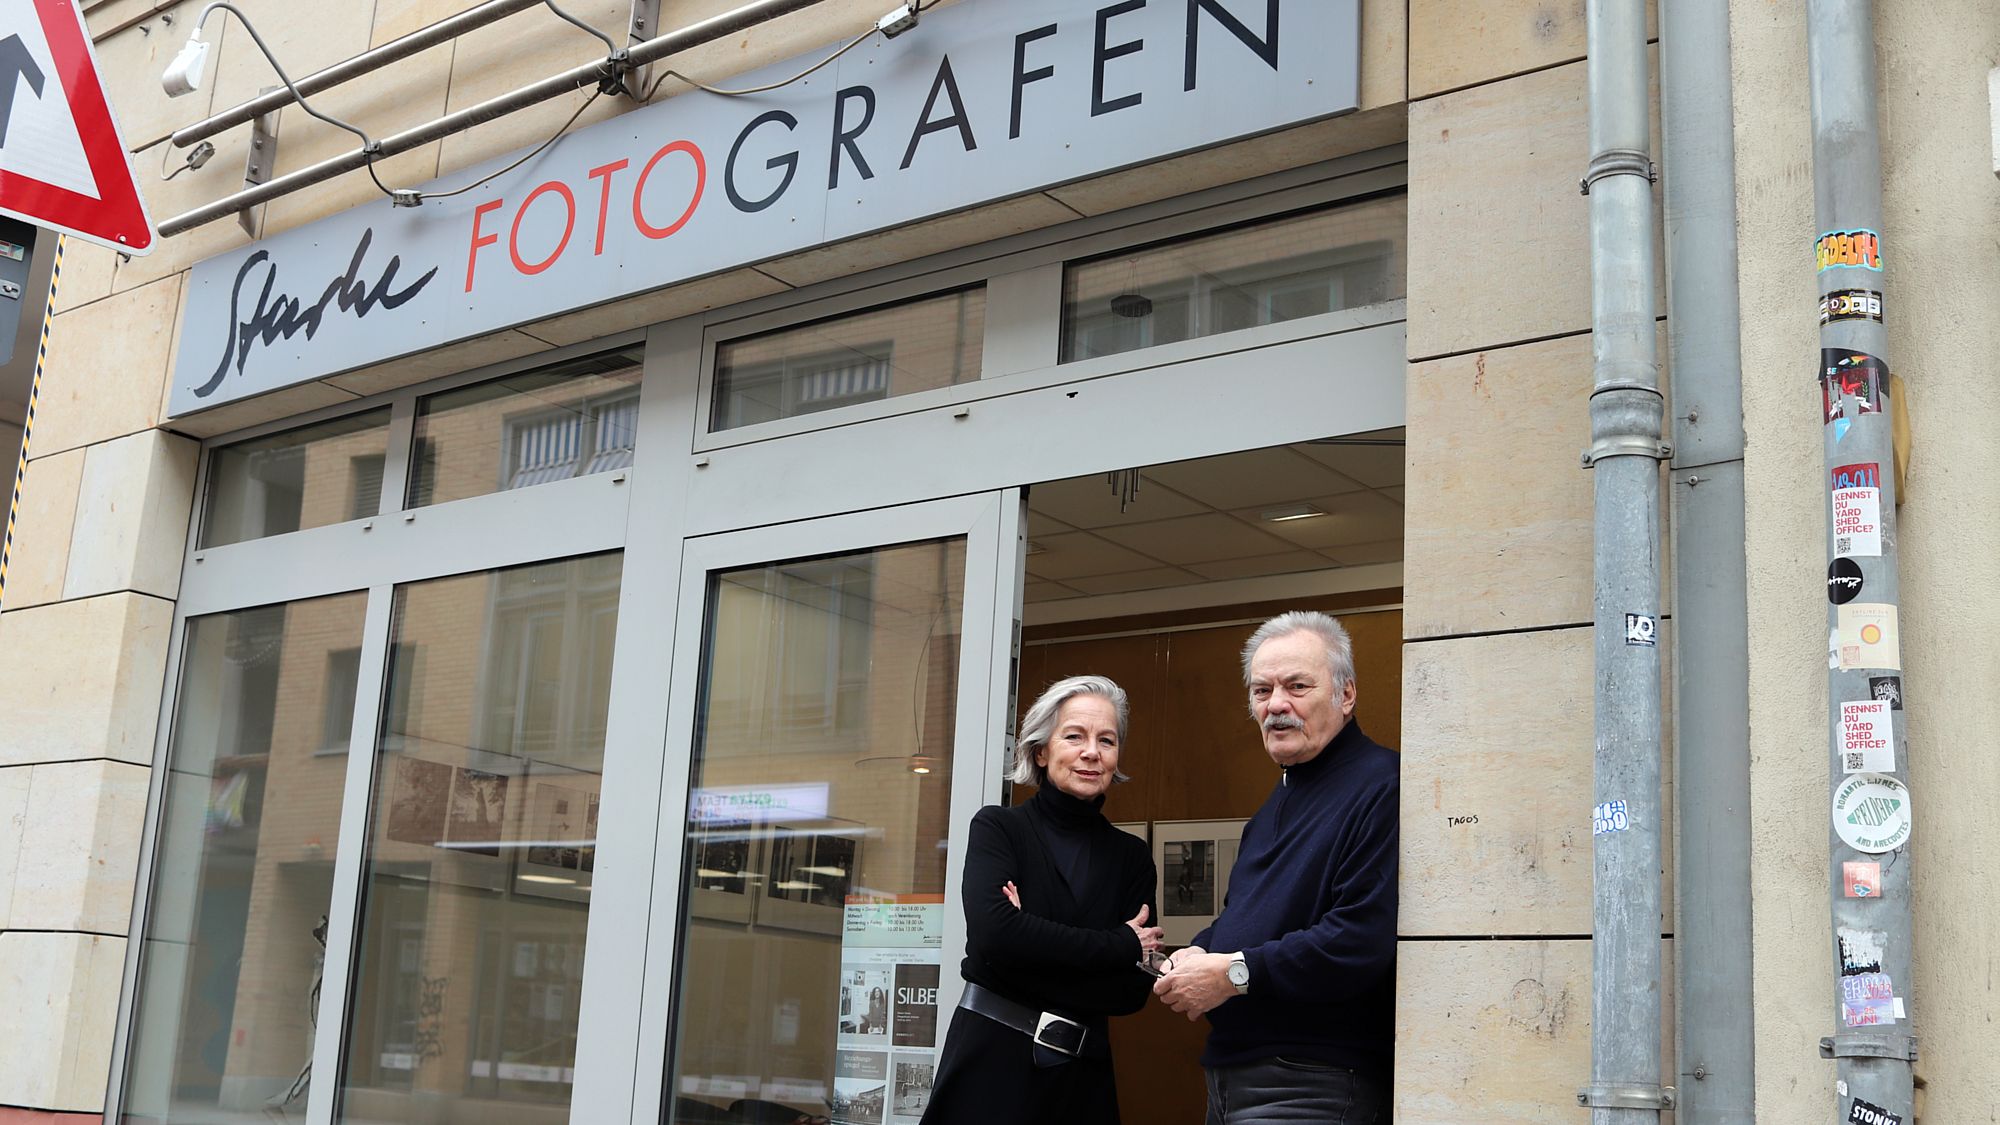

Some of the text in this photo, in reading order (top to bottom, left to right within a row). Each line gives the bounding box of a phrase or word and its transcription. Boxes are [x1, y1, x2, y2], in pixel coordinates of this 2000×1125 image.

[464, 0, 1278, 293] FOTOGRAFEN
[1835, 491, 1872, 501] KENNST
[1835, 501, 1848, 510] DU
[1835, 508, 1861, 518] YARD
[1836, 517, 1860, 527] SHED
[1836, 525, 1873, 535] OFFICE?
[1844, 704, 1883, 714] KENNST
[1844, 714, 1859, 723] DU
[1845, 722, 1873, 731] YARD
[1845, 731, 1872, 740] SHED
[1846, 740, 1886, 749] OFFICE?
[897, 987, 939, 1006] SILBE
[1848, 1014, 1878, 1025] JUNI
